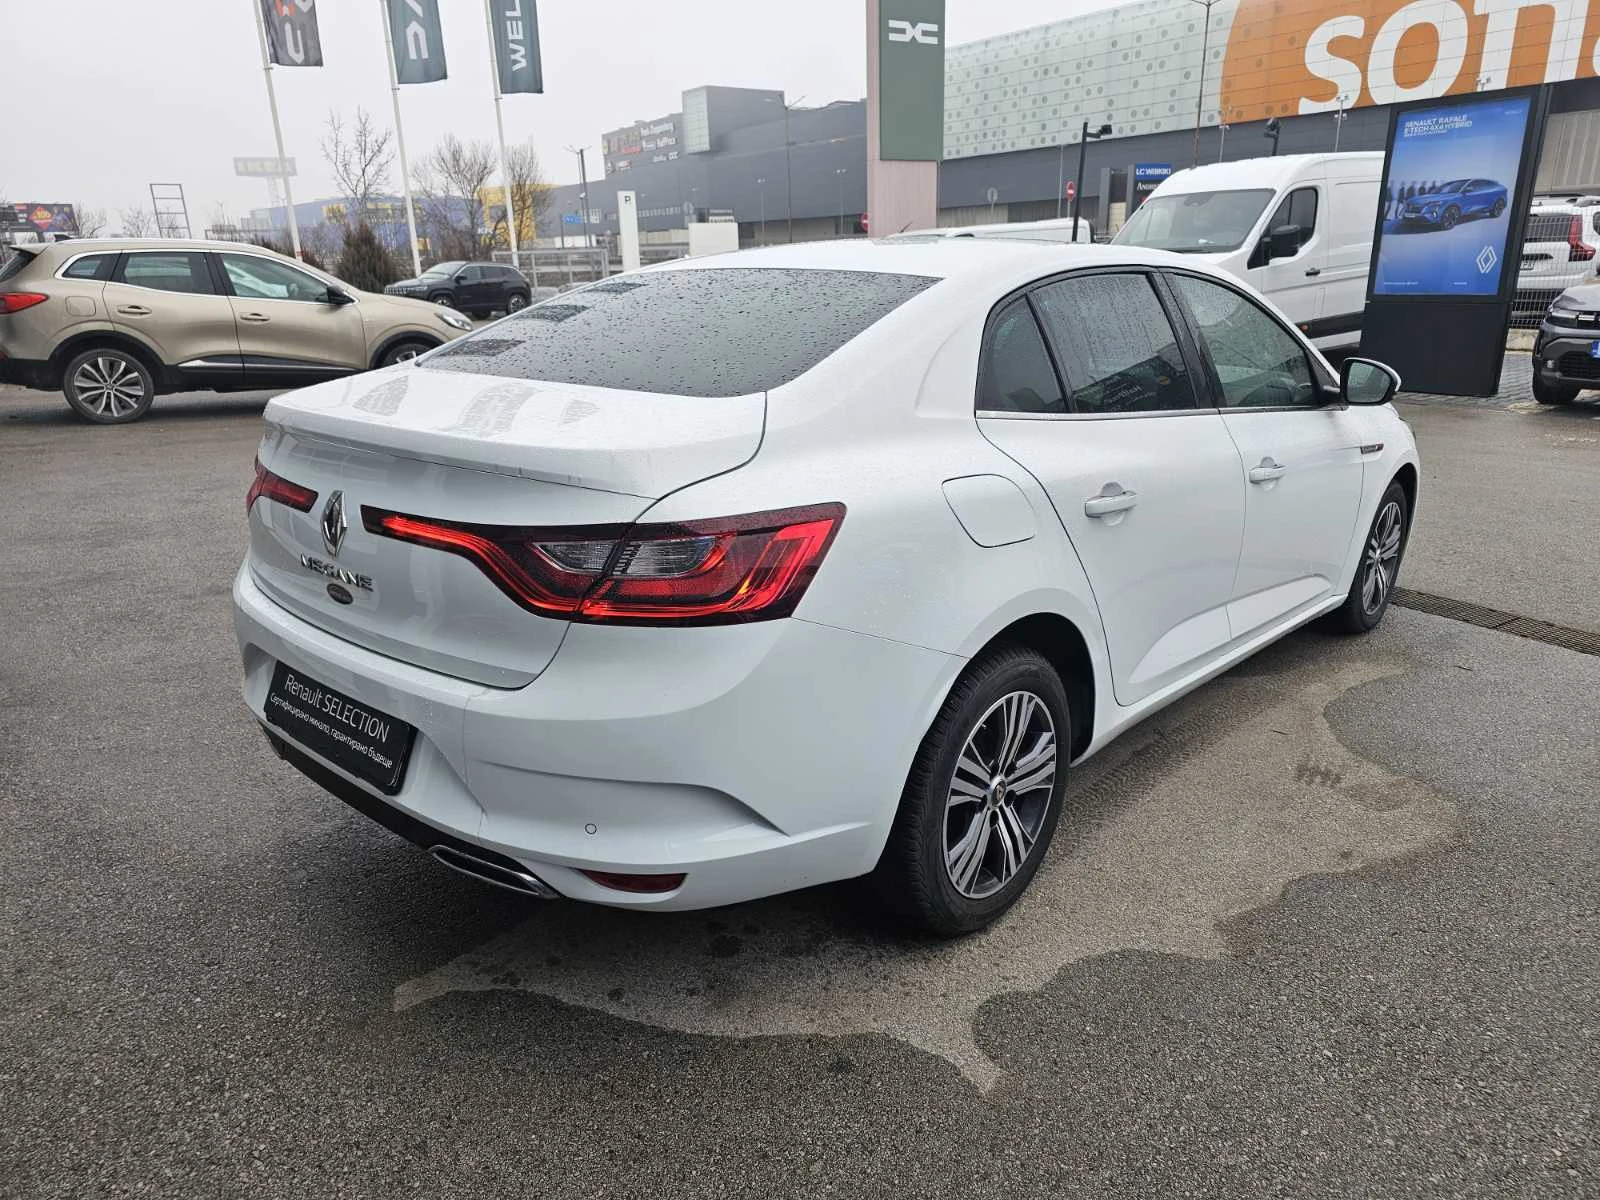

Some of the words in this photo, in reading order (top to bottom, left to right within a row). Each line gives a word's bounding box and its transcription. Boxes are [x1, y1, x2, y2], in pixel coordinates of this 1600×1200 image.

[1298, 0, 1600, 115] son
[1405, 118, 1437, 129] RENAULT
[1438, 114, 1468, 124] RAFALE
[300, 553, 374, 592] MEGANE
[284, 673, 322, 708] Renault
[322, 694, 390, 744] SELECTION
[331, 727, 367, 754] гарантирано
[367, 746, 393, 769] бъдеще
